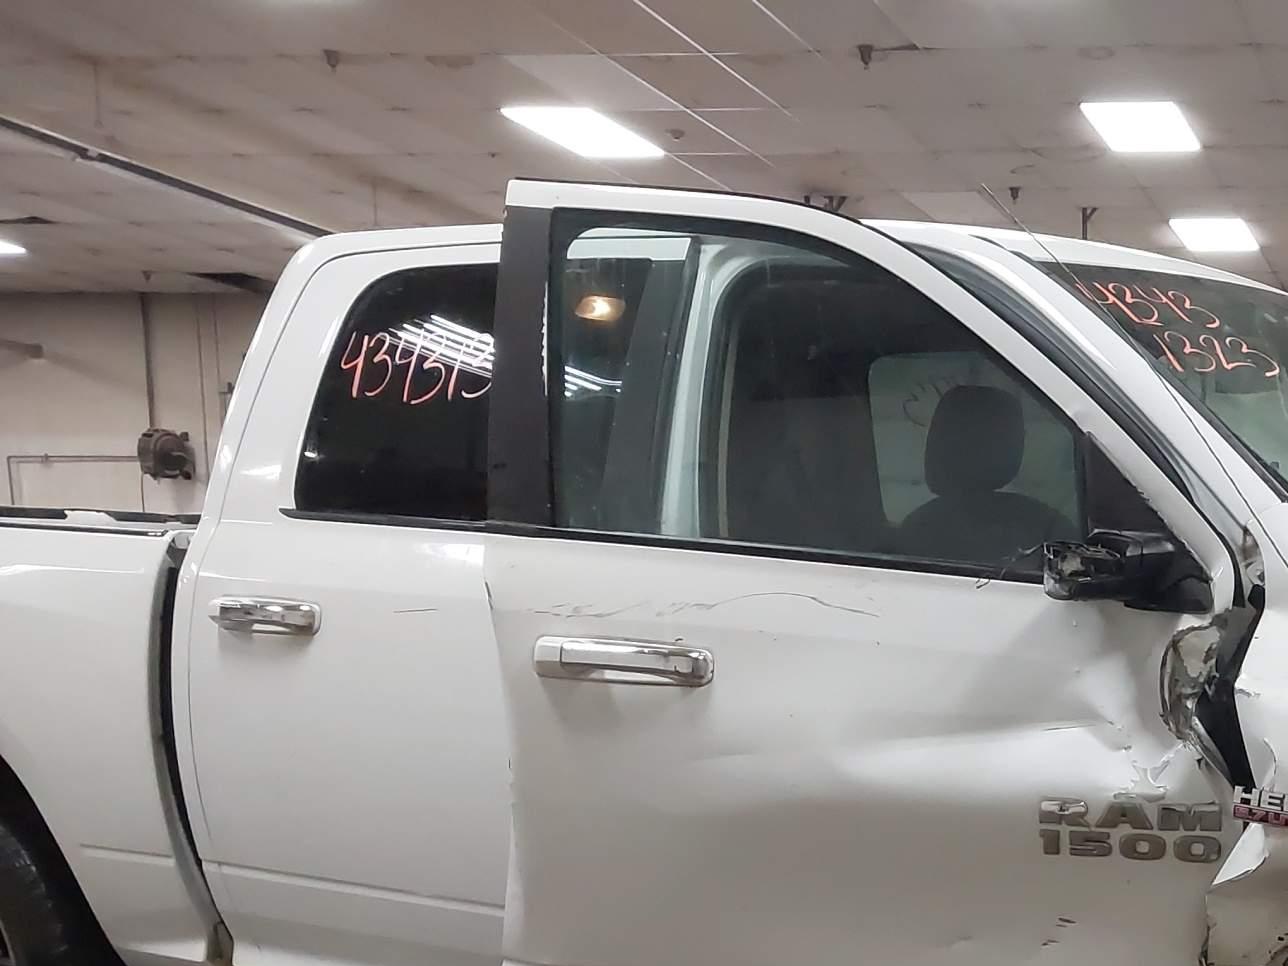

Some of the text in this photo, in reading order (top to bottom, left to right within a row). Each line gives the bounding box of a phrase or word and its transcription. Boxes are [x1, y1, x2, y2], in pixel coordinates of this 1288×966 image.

[1076, 280, 1220, 328] 4343
[1153, 331, 1279, 376] 1323
[1039, 800, 1222, 832] RAM
[1039, 829, 1222, 863] 1500
